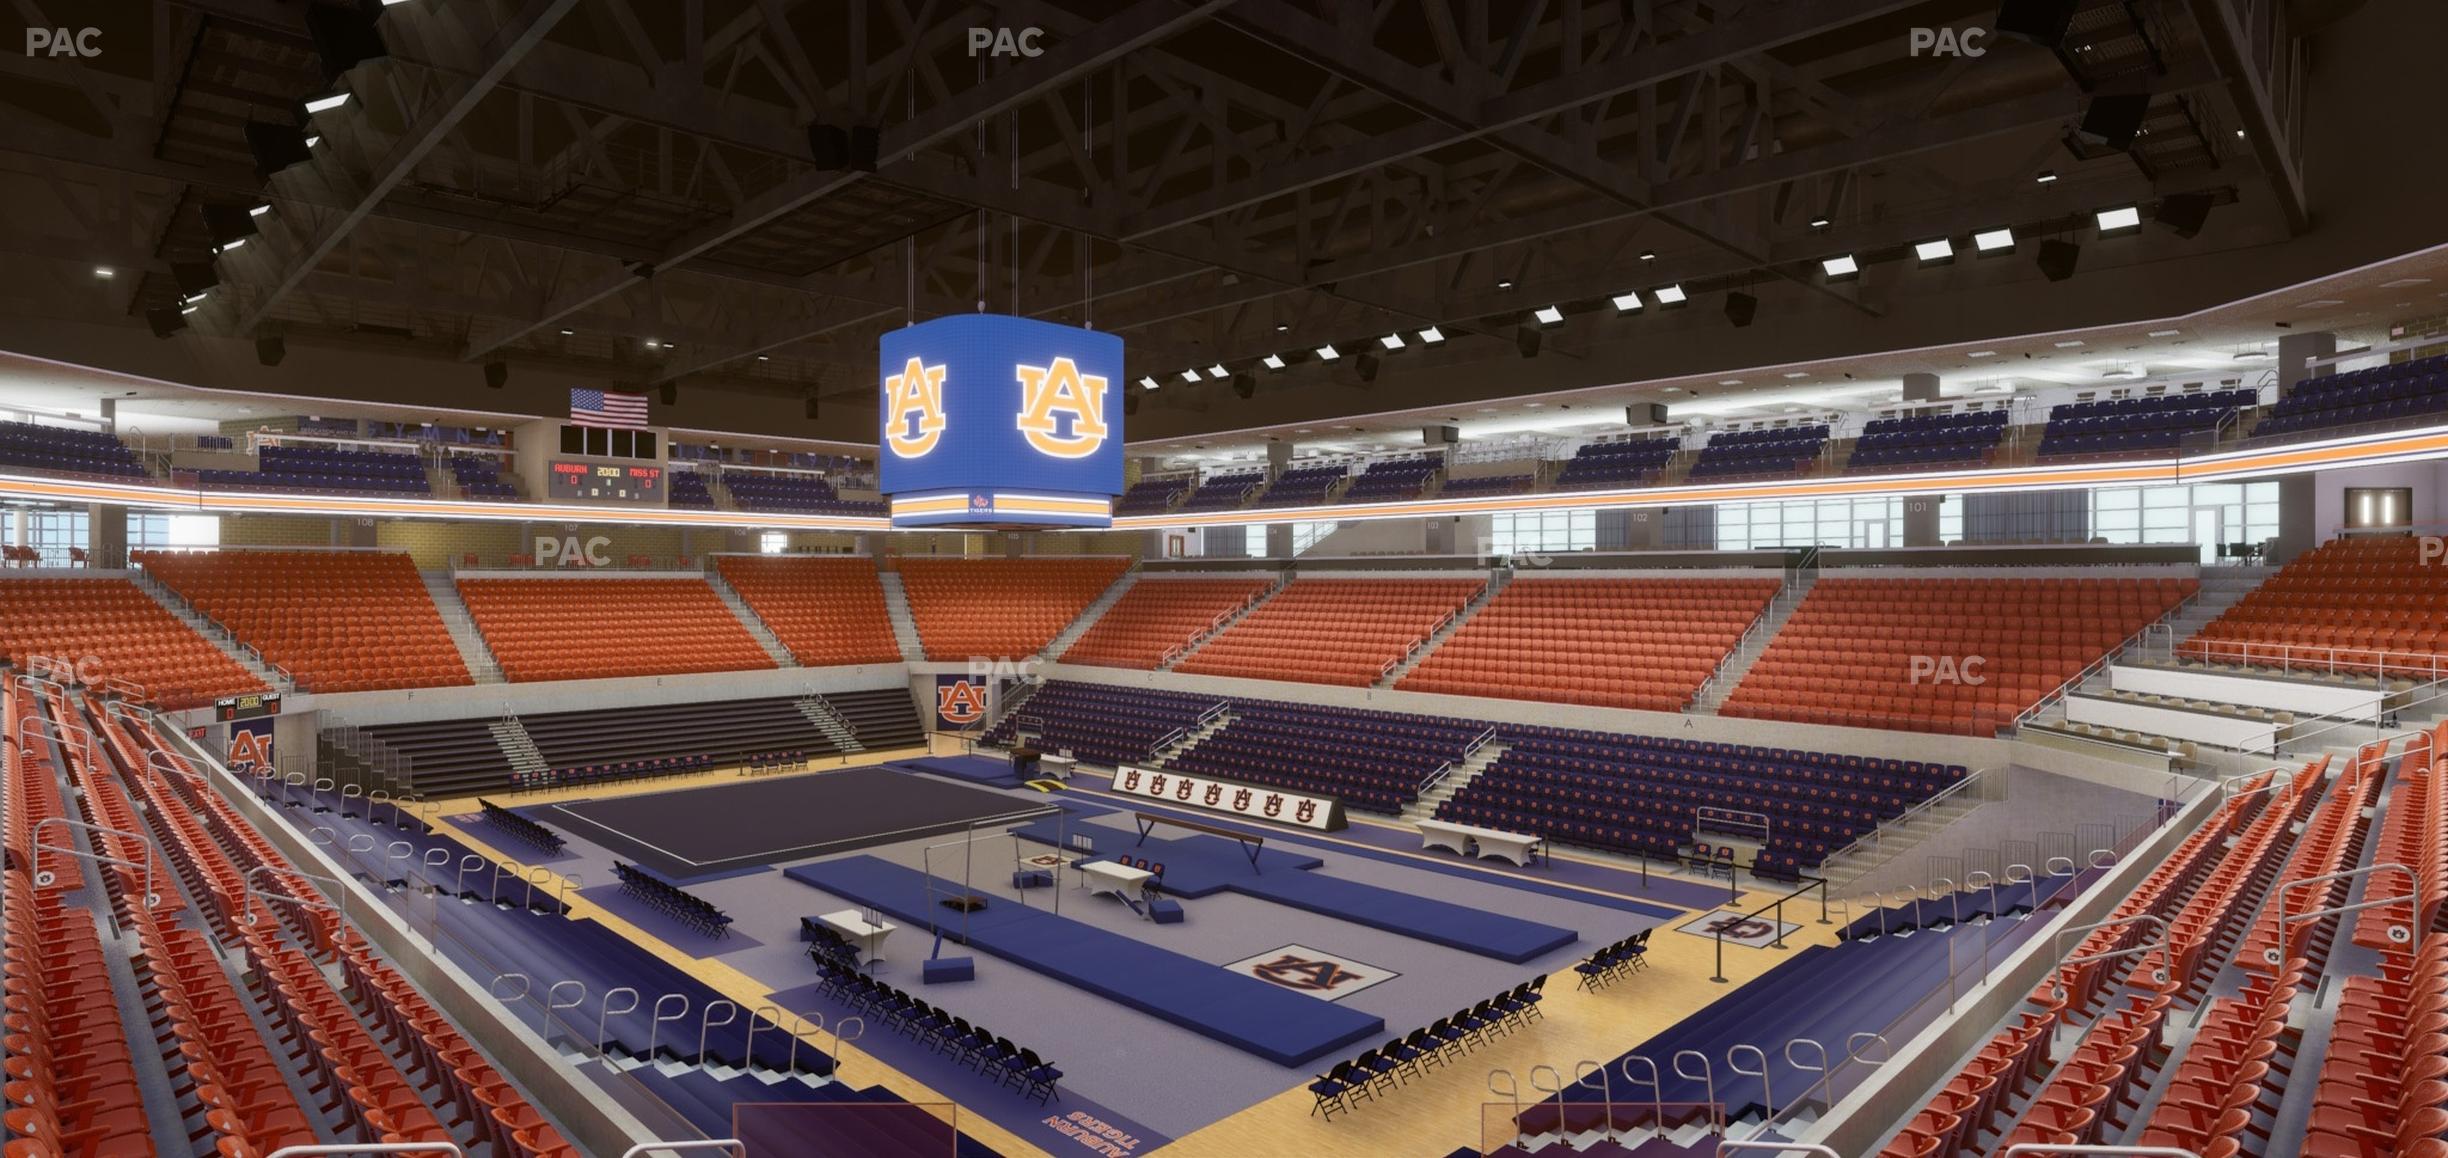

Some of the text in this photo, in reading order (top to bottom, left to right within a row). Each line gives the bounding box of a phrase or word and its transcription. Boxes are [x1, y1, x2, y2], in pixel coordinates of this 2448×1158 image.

[555, 464, 587, 474] AUBURN
[630, 468, 659, 478] MISS ST
[571, 475, 577, 485] 0
[645, 479, 652, 488] 0
[1910, 503, 1926, 512] 101
[358, 518, 374, 527] 108
[1634, 513, 1648, 522] 102
[218, 698, 235, 706] HOME
[262, 693, 280, 701] GUEST
[271, 702, 277, 714] 0
[227, 708, 233, 719] 0
[1684, 719, 1693, 728] A
[188, 728, 205, 738] EXIT
[1066, 1111, 1140, 1150] TIGERS
[1042, 1115, 1131, 1158] AUBURN
